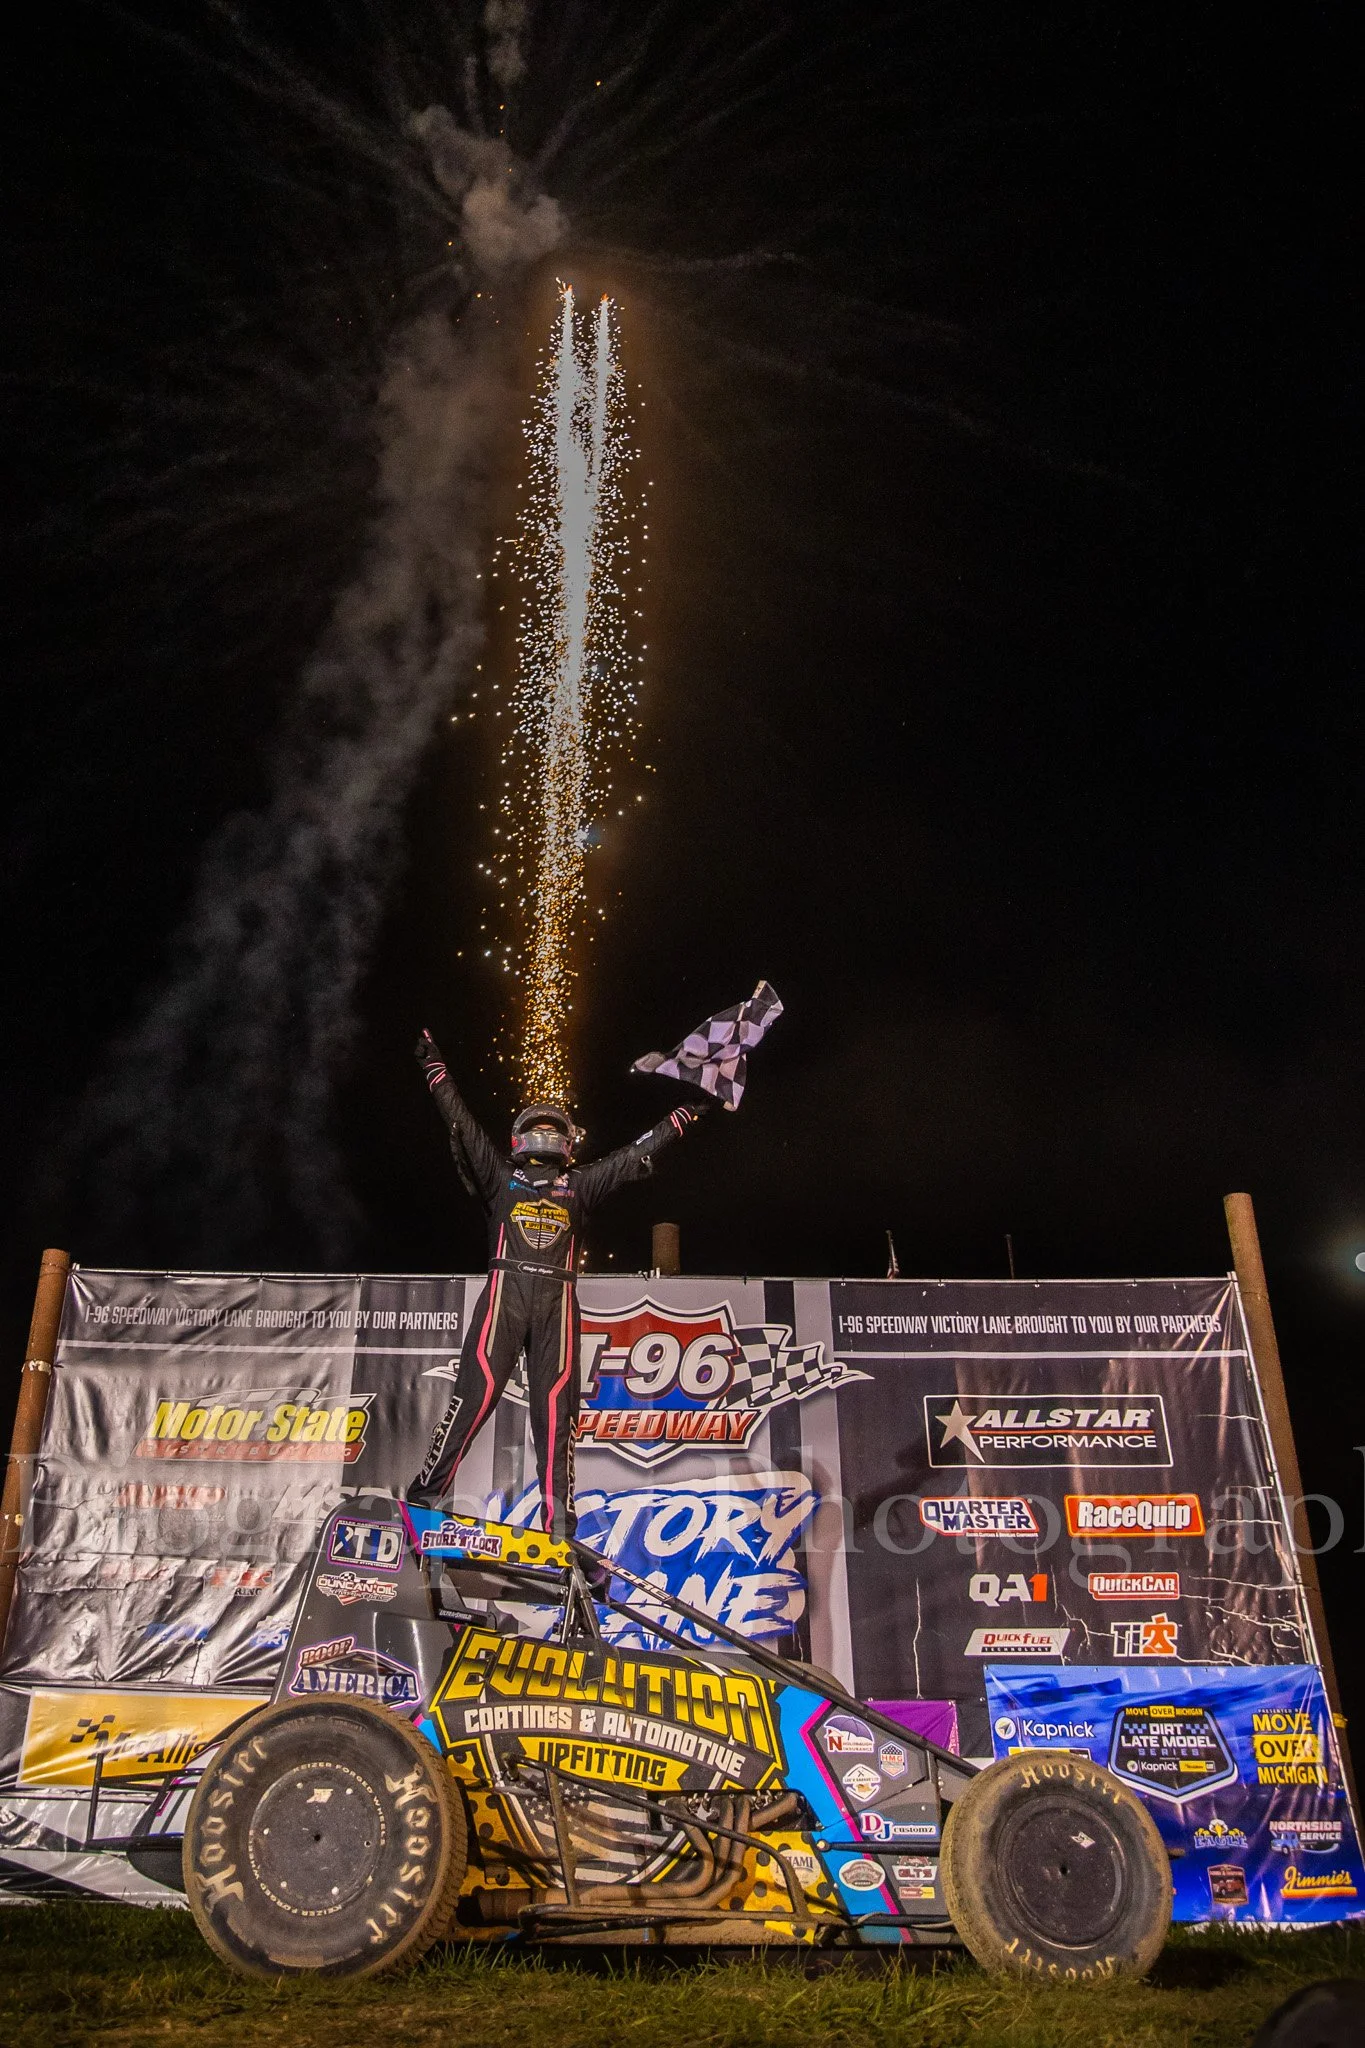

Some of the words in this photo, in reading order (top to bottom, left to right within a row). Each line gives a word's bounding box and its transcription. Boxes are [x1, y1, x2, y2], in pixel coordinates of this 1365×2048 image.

[84, 1304, 110, 1324] I-96
[111, 1306, 175, 1326] SPEEDWAY
[175, 1307, 221, 1327] VICTORY
[223, 1309, 254, 1328] LANE
[255, 1309, 308, 1329] BROUGHT
[312, 1310, 326, 1328] TO
[328, 1310, 352, 1329] YOU
[354, 1310, 370, 1329] BY
[372, 1311, 397, 1330] OUR
[399, 1311, 458, 1331] PARTNERS
[838, 1316, 864, 1334] I-96
[866, 1316, 929, 1335] SPEEDWAY
[930, 1316, 980, 1335] VICTORY
[982, 1316, 1013, 1334] LANE
[1015, 1316, 1069, 1334] BROUGHT
[1070, 1316, 1087, 1334] TO
[1089, 1316, 1113, 1334] YOU
[1115, 1316, 1132, 1334] BY
[1134, 1316, 1159, 1334] OUR
[1162, 1315, 1222, 1334] PARTNERS
[580, 1331, 738, 1400] I-96
[149, 1401, 265, 1441] Motor
[266, 1403, 366, 1442] State
[577, 1410, 752, 1440] PEEDWAY
[974, 1408, 1155, 1429] ALLSTAR
[979, 1434, 1157, 1450] PERFORMANCE
[923, 1500, 1025, 1522] QUARTER
[1077, 1500, 1192, 1530] RaceQuip
[486, 1487, 820, 1567] VCTORY
[942, 1514, 1032, 1531] MASTER
[422, 1531, 457, 1549] STORE
[471, 1536, 501, 1556] LOCK
[968, 1573, 1048, 1607] QA1
[983, 1632, 1022, 1646] QUICK
[291, 1667, 418, 1699] AMERICA
[443, 1633, 773, 1757] EVOLUTION
[1125, 1707, 1149, 1717] MOVE
[1151, 1707, 1173, 1716] OVER
[1252, 1713, 1313, 1732] MOVE
[1022, 1719, 1095, 1740] Kapnick
[1148, 1722, 1184, 1735] DIRT
[463, 1705, 573, 1734] COATINGS
[580, 1709, 596, 1733] &
[602, 1713, 746, 1777] AUTOMOTIVE
[1120, 1735, 1161, 1748] LATE
[1162, 1735, 1217, 1748] MODEL
[1259, 1740, 1316, 1758] OVER
[1138, 1748, 1200, 1756] SERIES
[538, 1743, 667, 1787] UPFITTING
[1140, 1761, 1179, 1773] Kapnick
[1257, 1765, 1329, 1785] MICHIGAN
[1269, 1820, 1342, 1832] NORTHSIDE
[1300, 1832, 1342, 1841] SERVICE
[1193, 1834, 1249, 1849] EAGLE
[1282, 1865, 1353, 1890] Jimmie's
